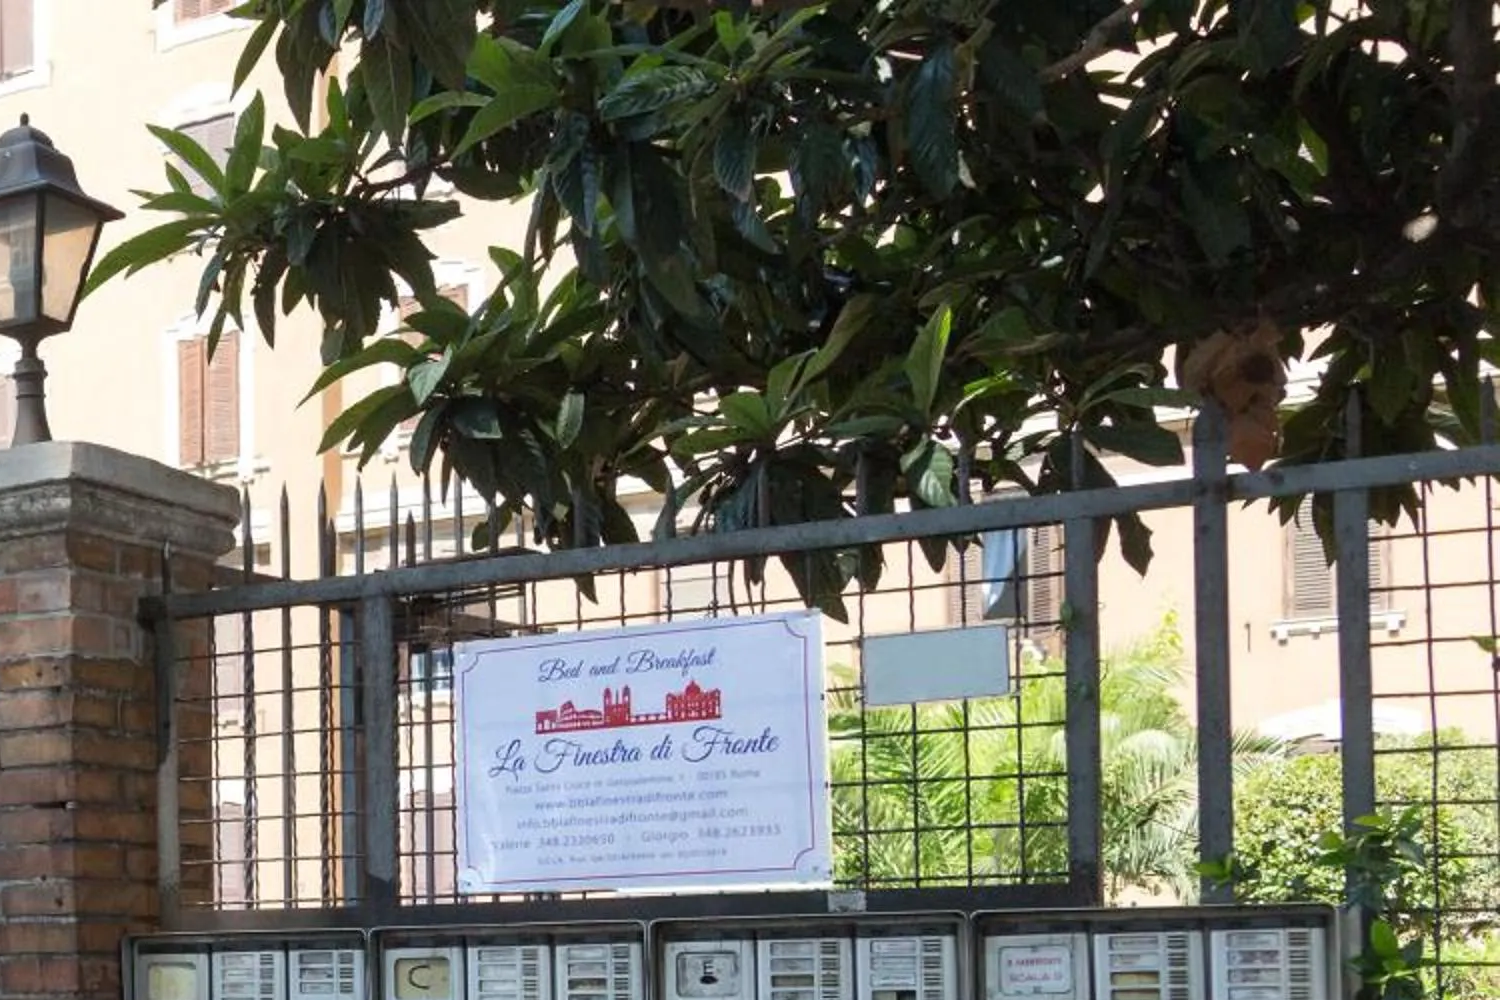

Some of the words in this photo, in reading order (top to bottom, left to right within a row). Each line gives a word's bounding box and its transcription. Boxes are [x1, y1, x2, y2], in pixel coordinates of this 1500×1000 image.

[538, 657, 584, 683] Bed
[589, 655, 620, 676] and
[626, 647, 717, 678] Breakfast
[488, 738, 527, 783] La
[534, 737, 641, 774] Finestra
[651, 733, 673, 762] di
[682, 725, 780, 763] Fronte
[407, 964, 431, 991] C
